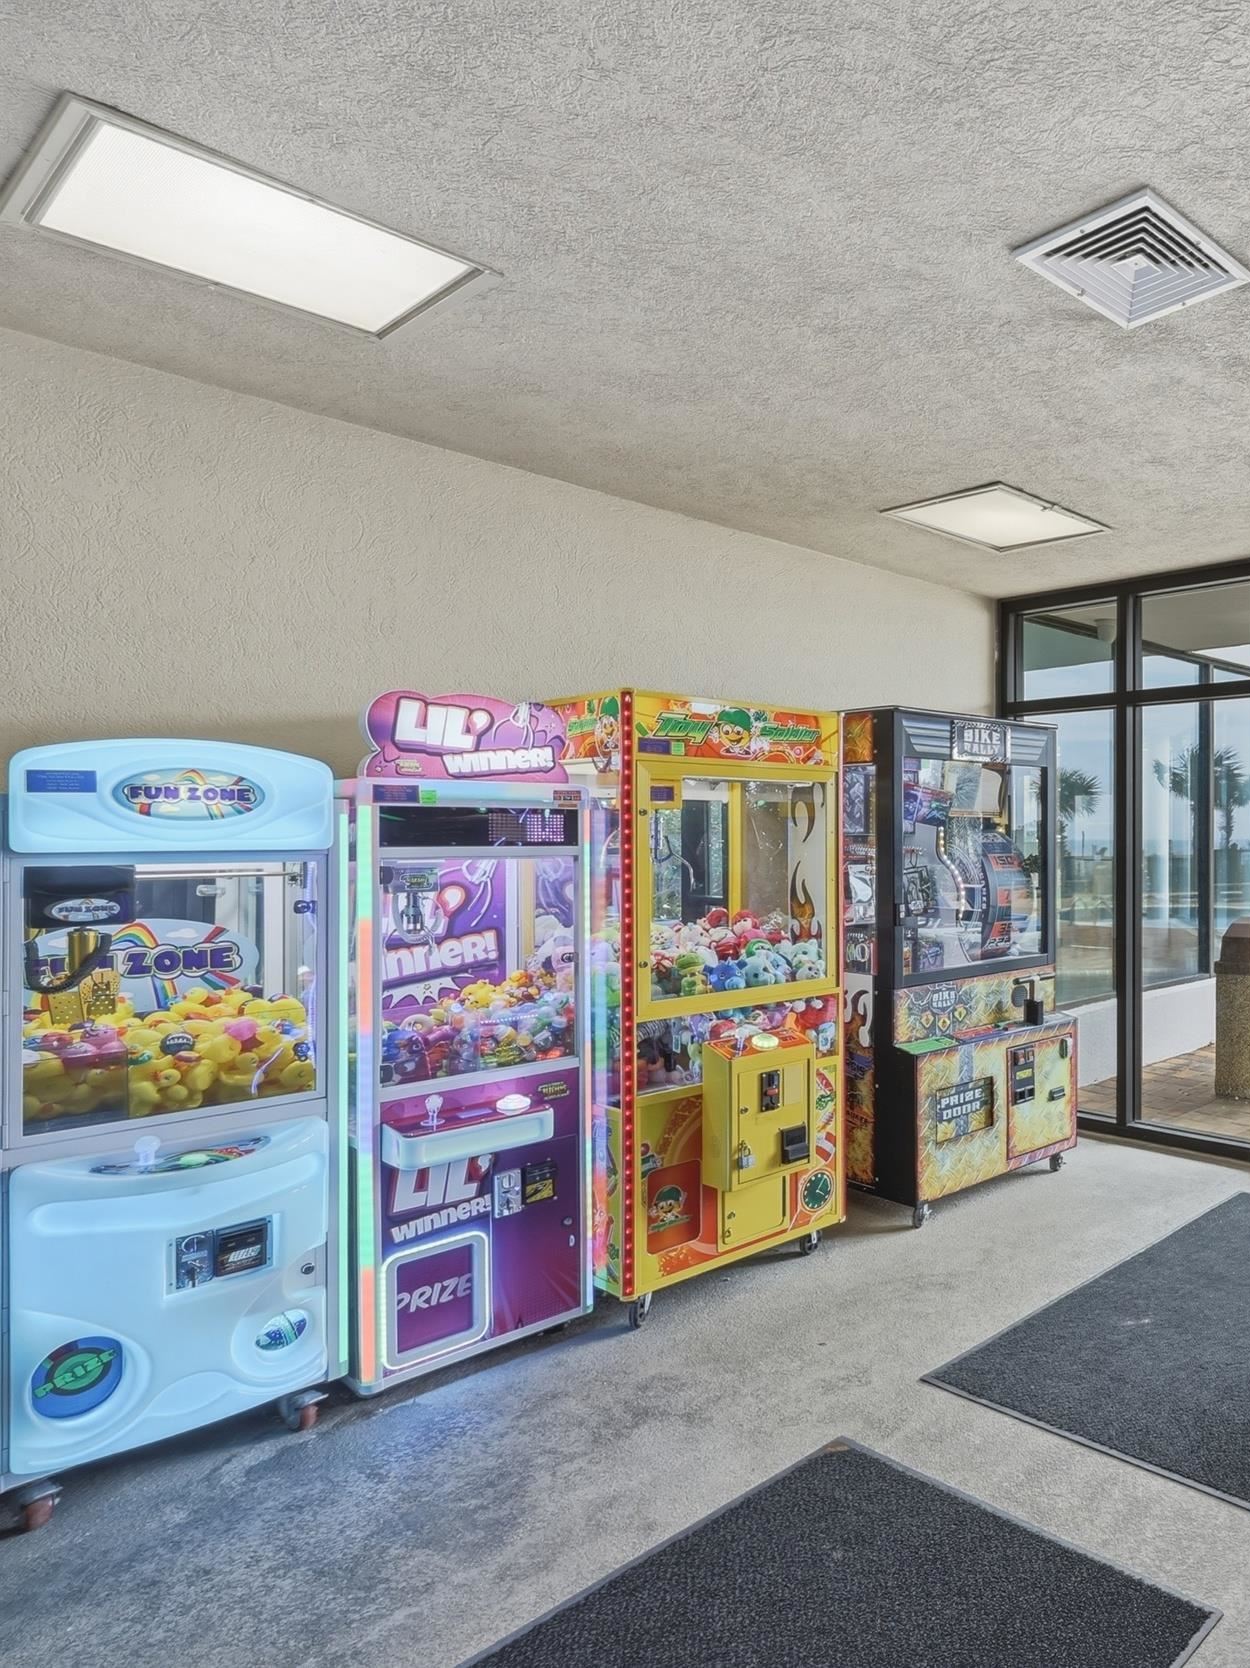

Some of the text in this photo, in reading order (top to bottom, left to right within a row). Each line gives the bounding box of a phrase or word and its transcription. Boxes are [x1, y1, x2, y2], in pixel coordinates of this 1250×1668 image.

[653, 713, 716, 744] Toy
[963, 728, 1001, 744] BIKE
[963, 742, 1001, 755] RALLY
[129, 785, 253, 802] FUN ZONE
[123, 946, 234, 976] ZONE
[940, 1088, 983, 1107] PRIZE
[942, 1101, 981, 1121] DOOR
[397, 1272, 472, 1313] PRIZE
[33, 1348, 117, 1399] PRIZE
